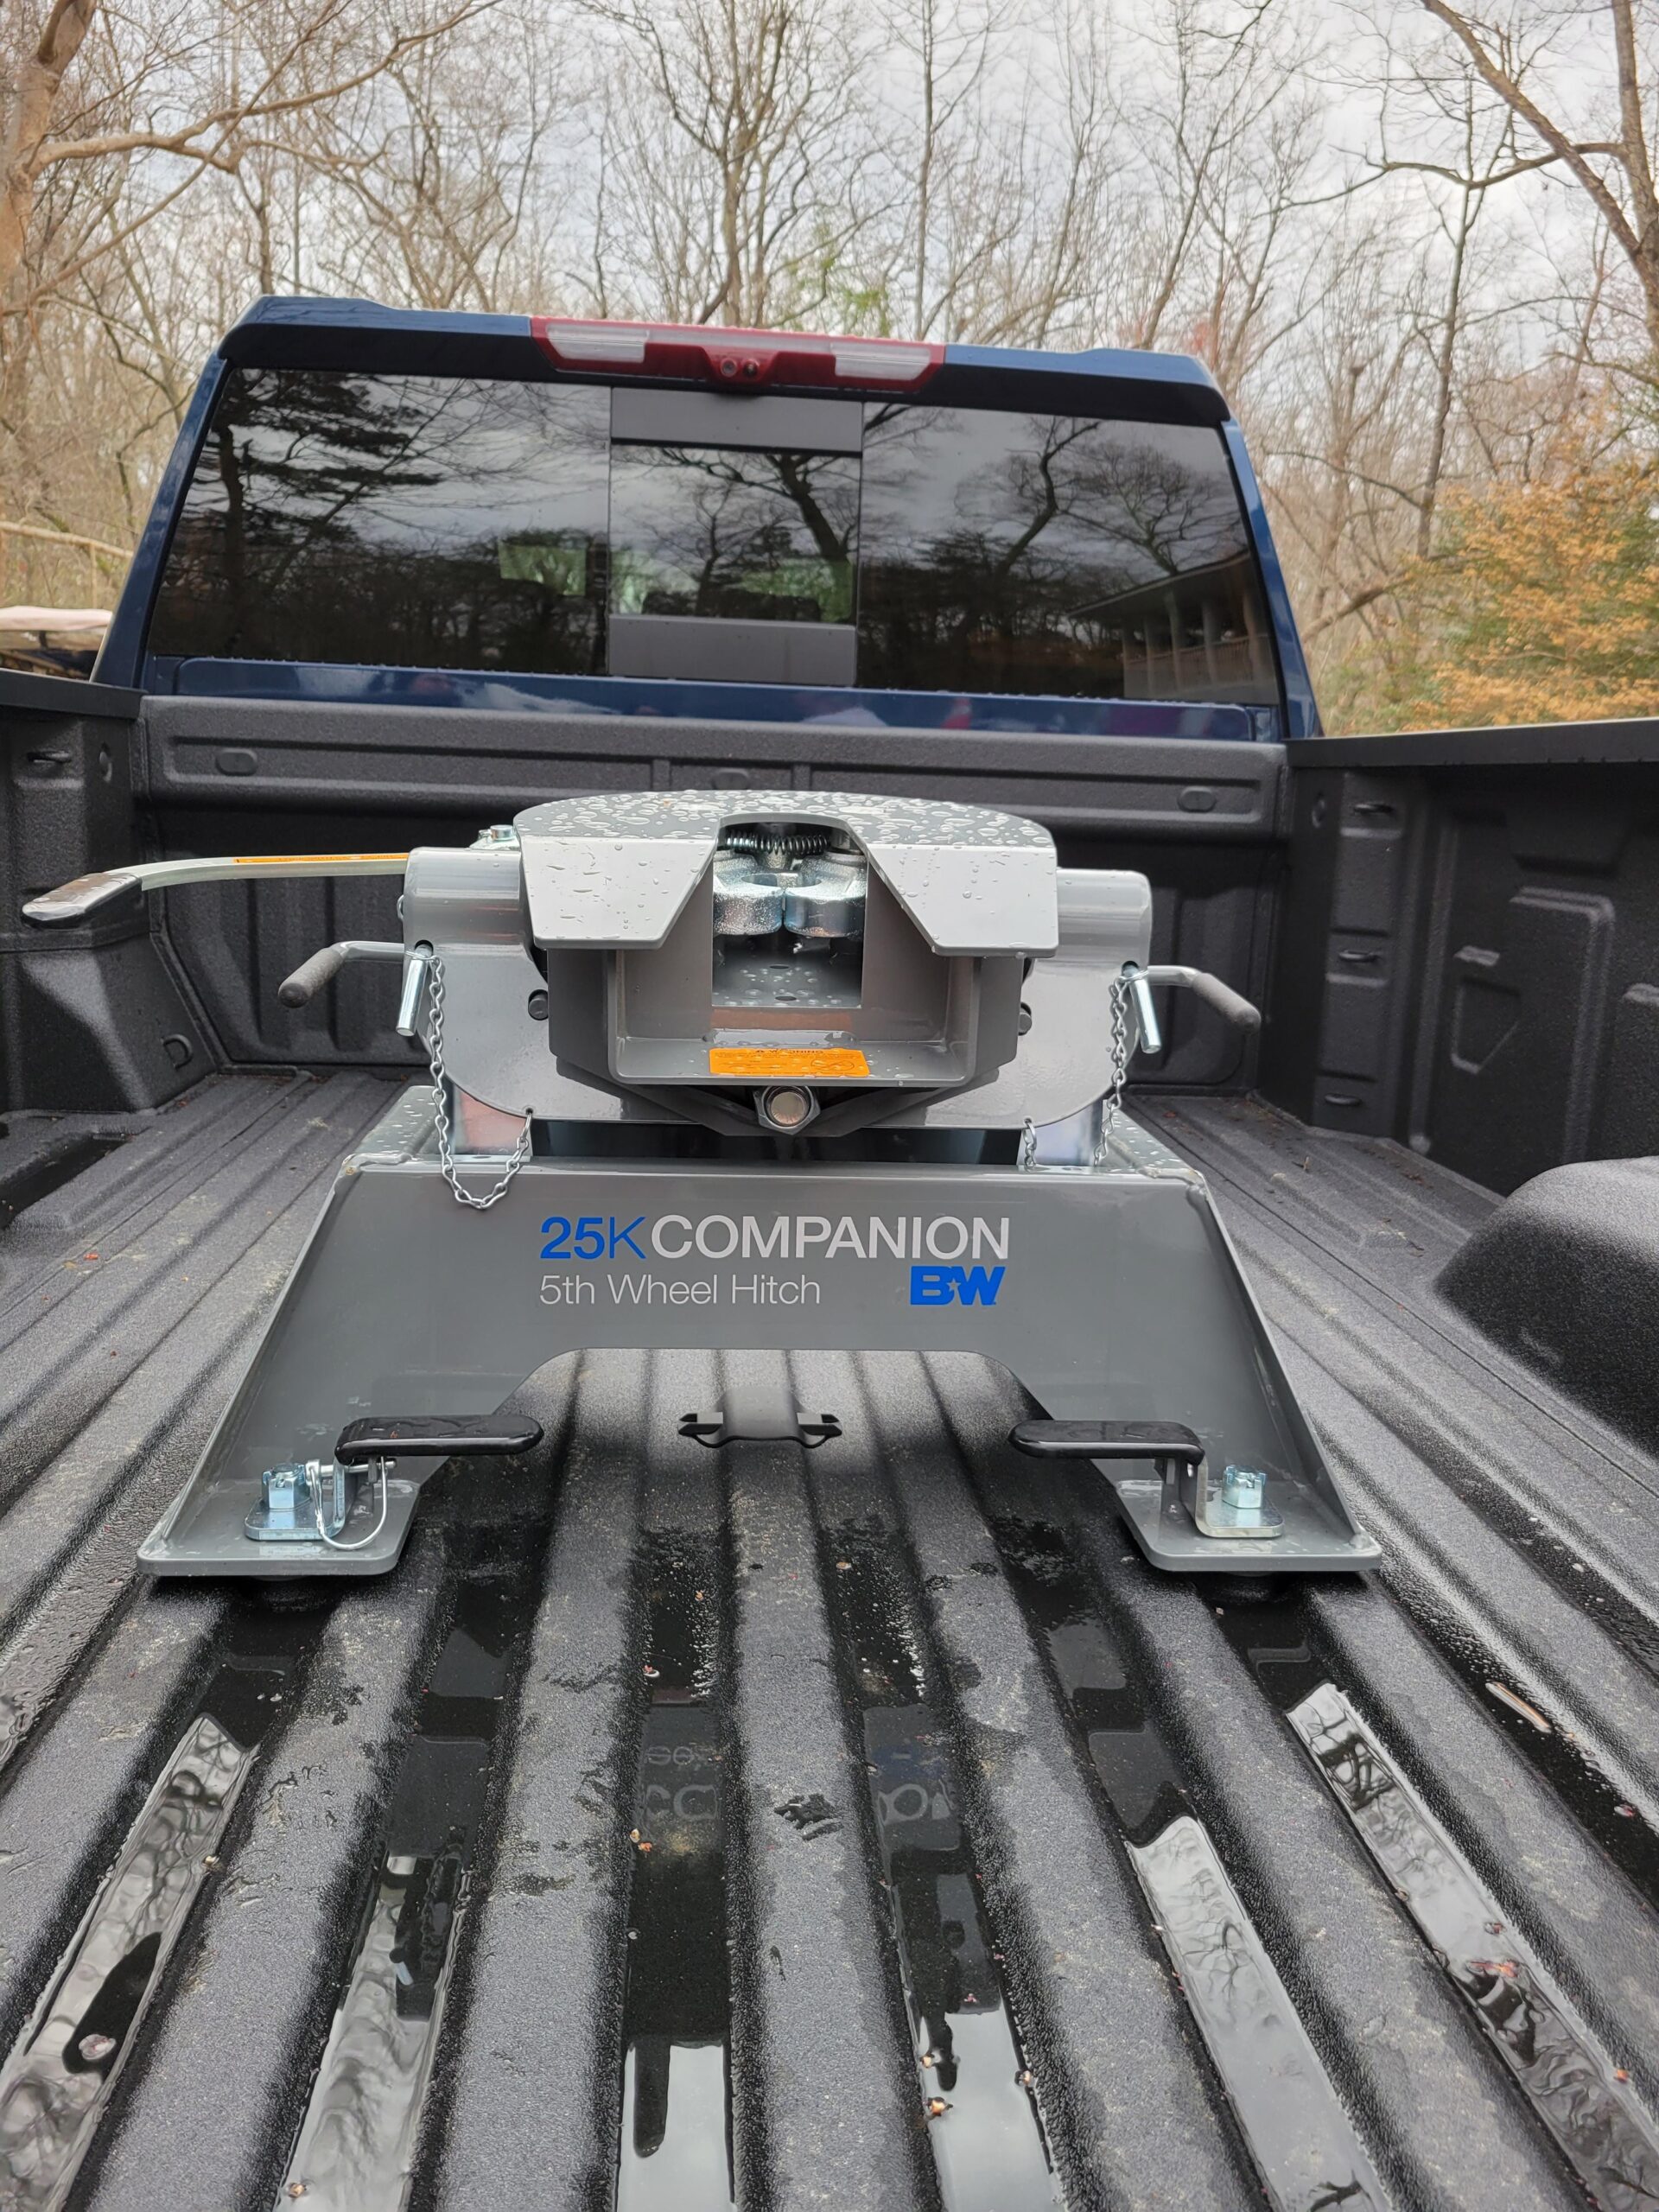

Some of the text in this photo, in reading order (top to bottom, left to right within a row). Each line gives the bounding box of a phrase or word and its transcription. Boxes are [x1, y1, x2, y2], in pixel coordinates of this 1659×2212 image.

[540, 1214, 1010, 1259] 25K COMPANION
[539, 1274, 821, 1304] 5th Wheel Hitch
